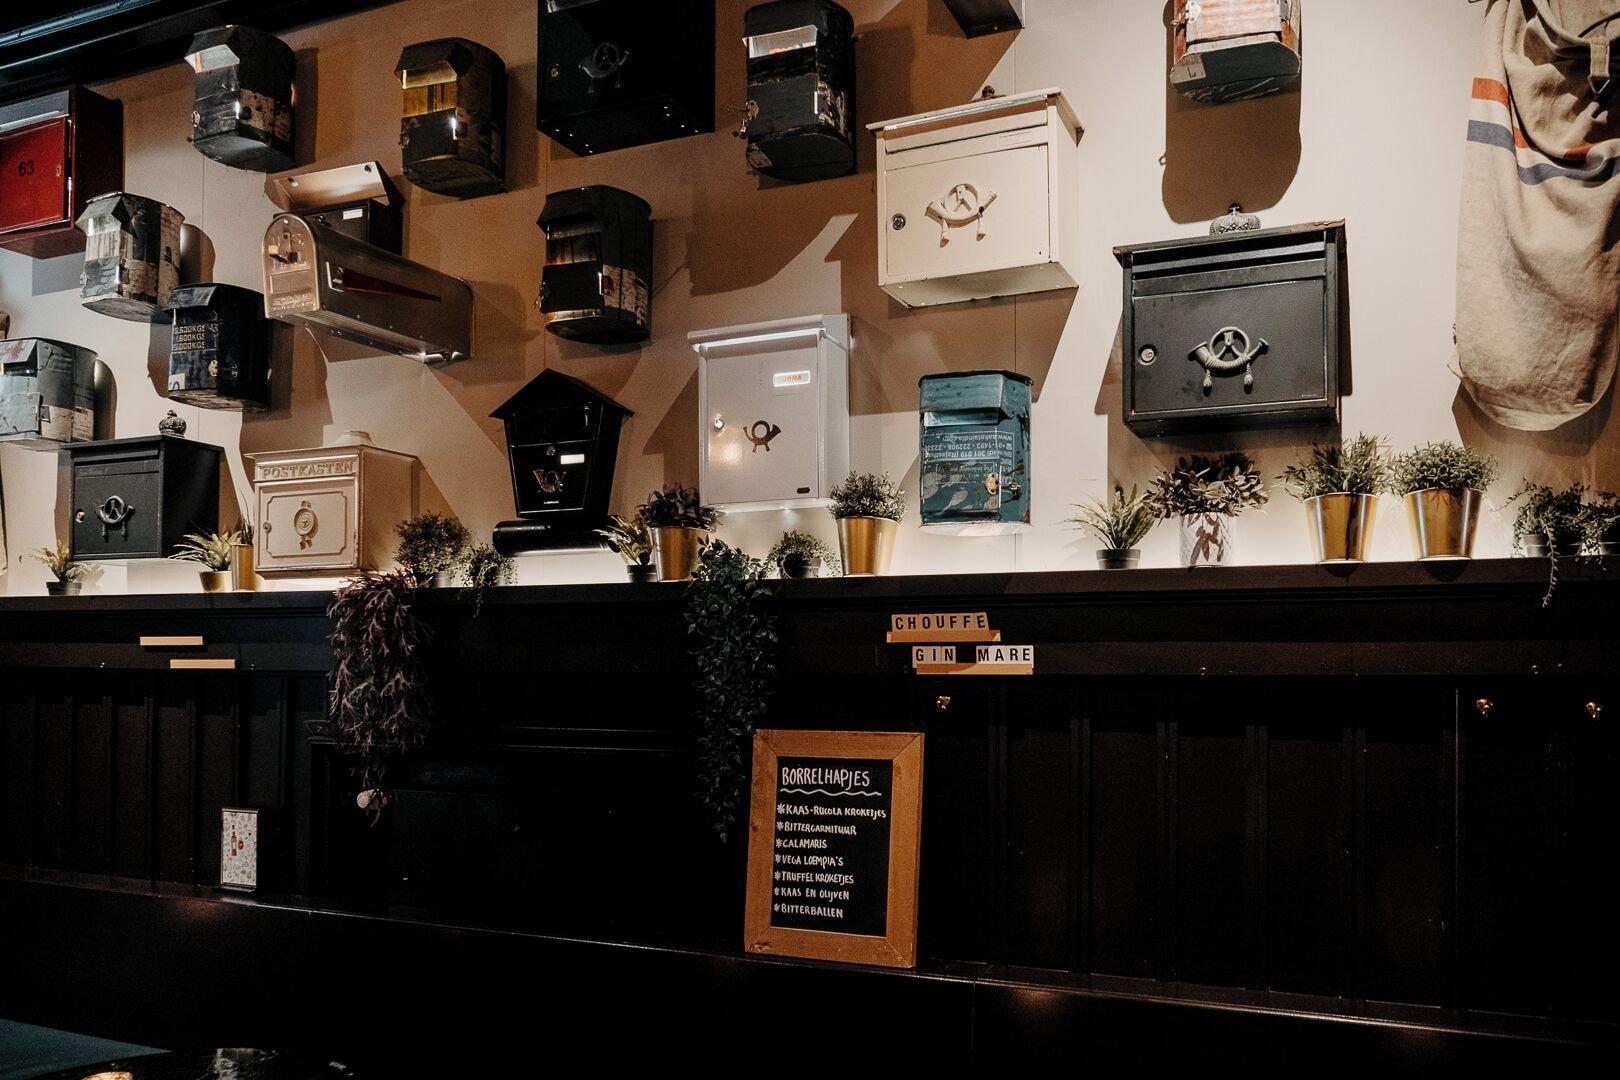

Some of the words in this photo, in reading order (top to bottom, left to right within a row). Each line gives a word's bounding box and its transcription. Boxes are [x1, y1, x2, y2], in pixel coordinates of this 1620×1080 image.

[18, 160, 35, 177] 63
[262, 460, 355, 479] POSTKASTEN
[895, 614, 985, 630] CHOUFFE
[915, 648, 953, 661] GIN
[978, 648, 1030, 662] MARE
[782, 766, 870, 791] BORRELHAPJES
[785, 805, 843, 816] KAAS-RUCOLA
[844, 807, 887, 820] KROKETJES
[784, 821, 857, 835] BITTERGARNITUUR
[782, 838, 827, 849] CALAMARIS
[782, 855, 802, 865] VEGA
[804, 855, 844, 870] LOEMPIA'S
[781, 871, 814, 882] TRUFFEL
[815, 873, 854, 885] KROKETJES
[781, 887, 802, 897] KAAS
[805, 888, 817, 898] EN
[819, 890, 850, 903] OLIJVEN
[781, 904, 843, 919] BITTERBALLEN
